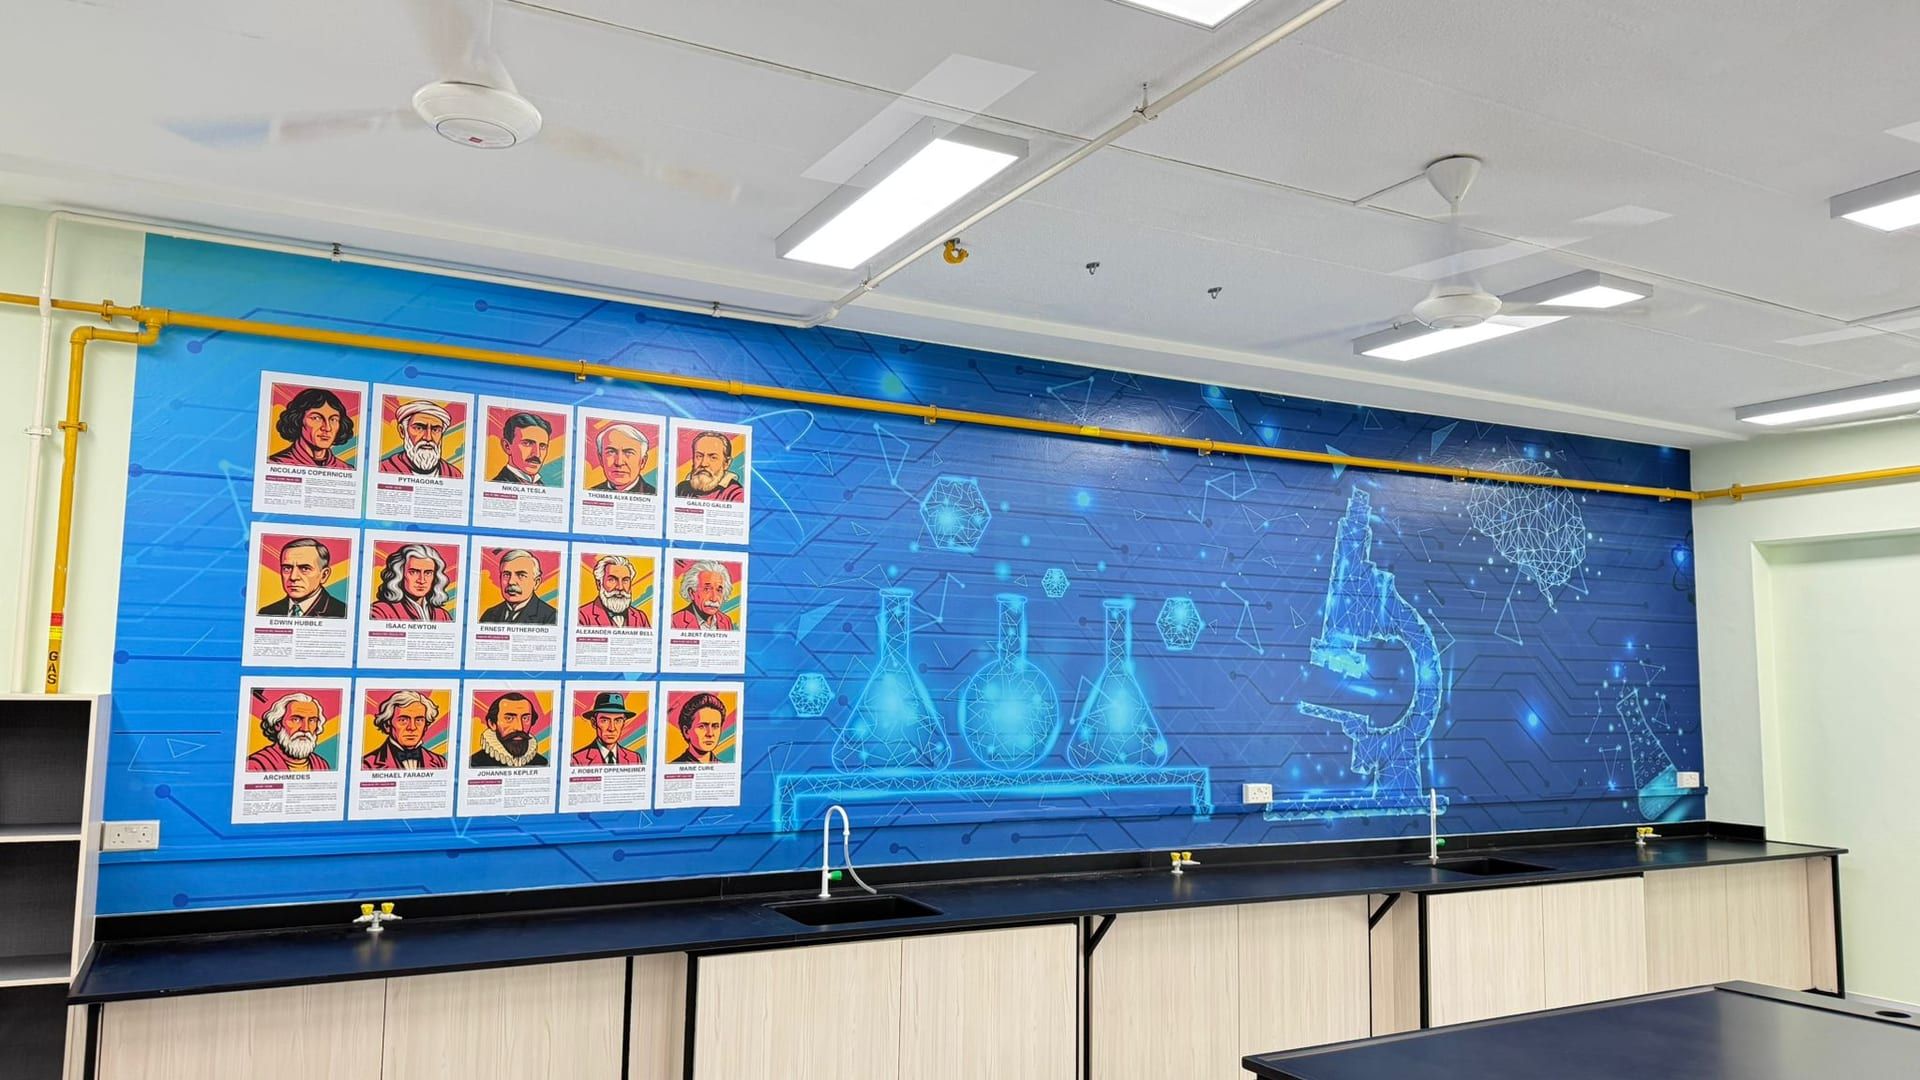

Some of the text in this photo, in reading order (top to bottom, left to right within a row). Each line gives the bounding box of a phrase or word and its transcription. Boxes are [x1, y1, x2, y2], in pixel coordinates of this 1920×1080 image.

[270, 466, 352, 478] NICOLAUS COPERNICUS
[398, 477, 443, 485] PYTHAGORAS
[48, 651, 58, 684] GAS
